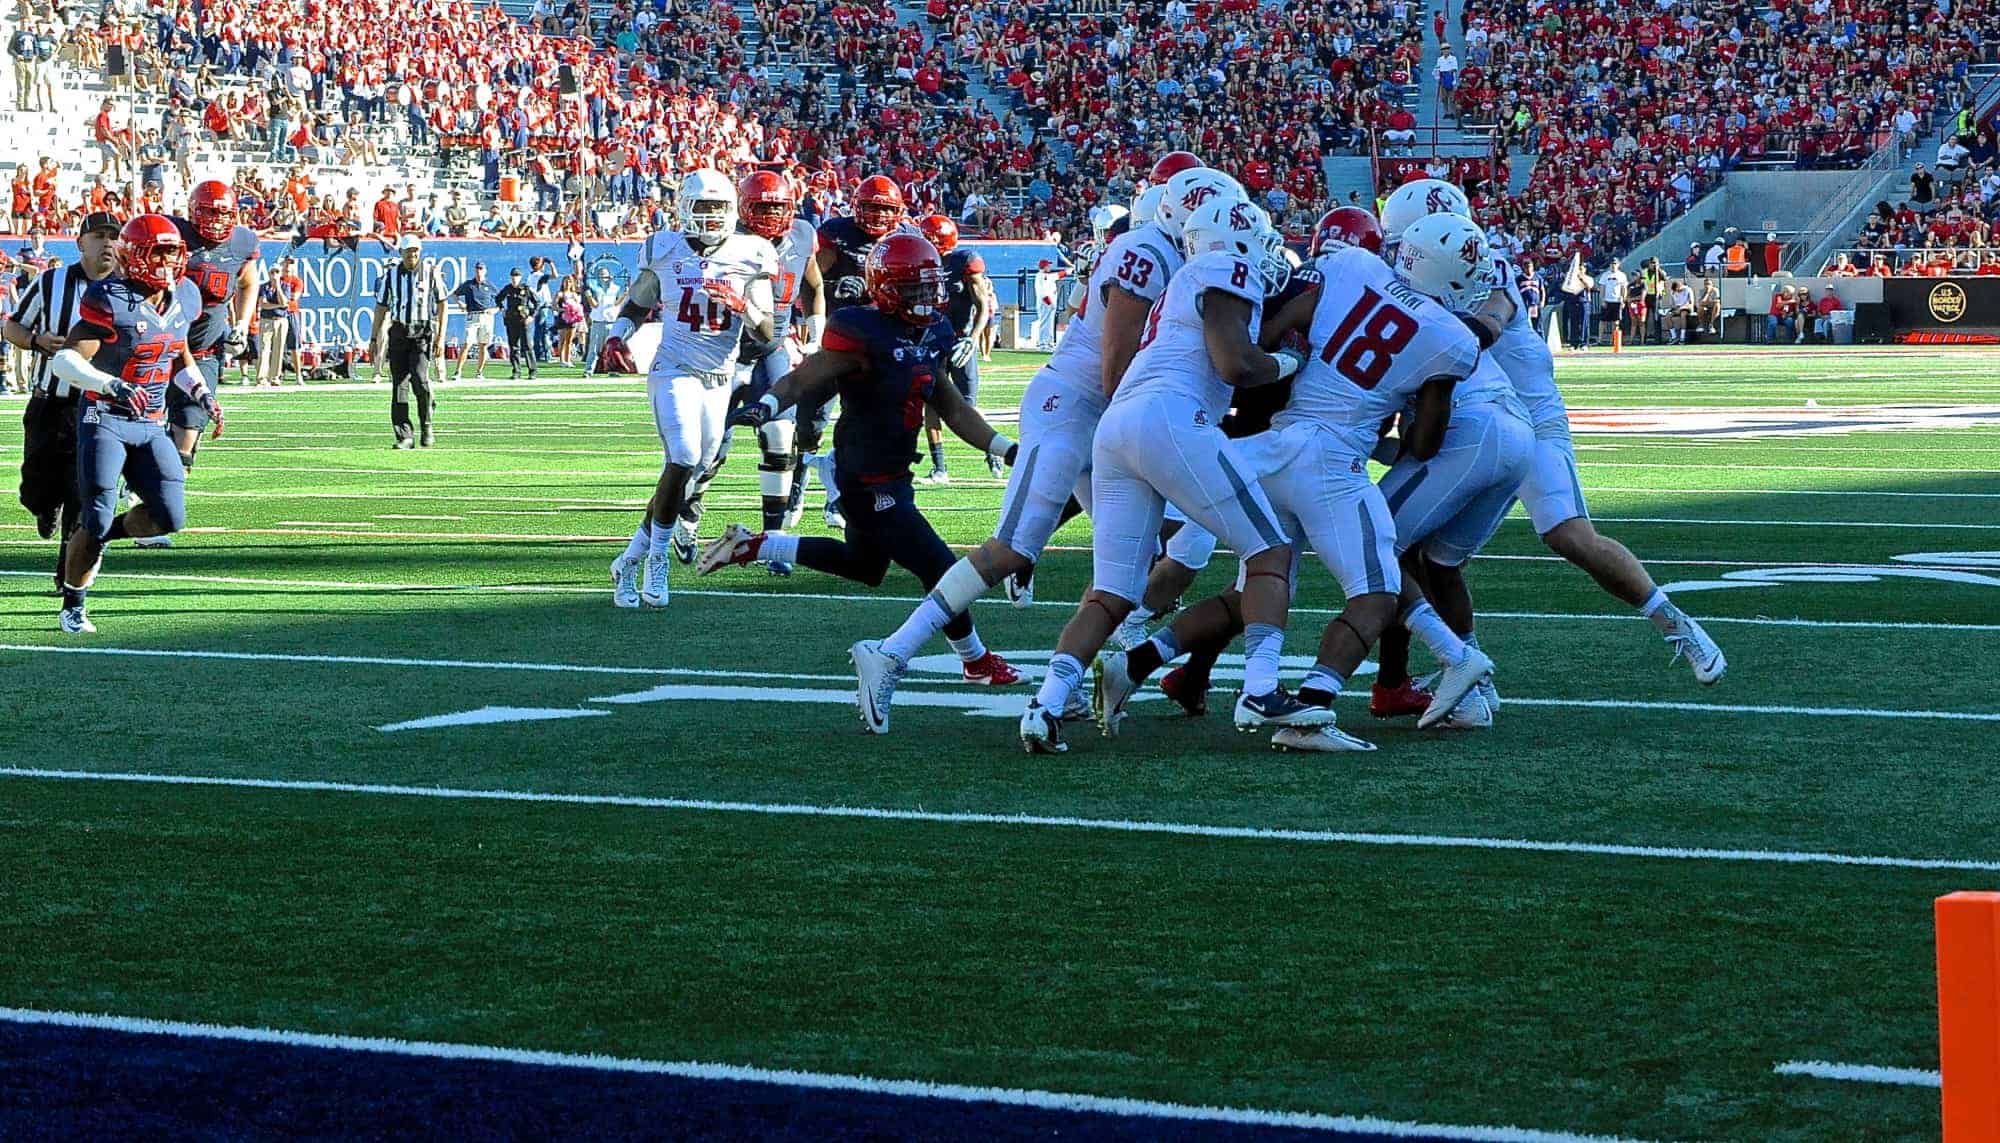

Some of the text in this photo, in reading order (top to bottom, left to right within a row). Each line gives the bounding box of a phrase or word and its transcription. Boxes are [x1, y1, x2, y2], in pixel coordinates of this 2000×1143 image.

[1117, 249, 1154, 289] 33
[1230, 260, 1249, 289] 8
[300, 306, 374, 347] RESO
[676, 286, 732, 332] 40
[1319, 284, 1420, 391] 18
